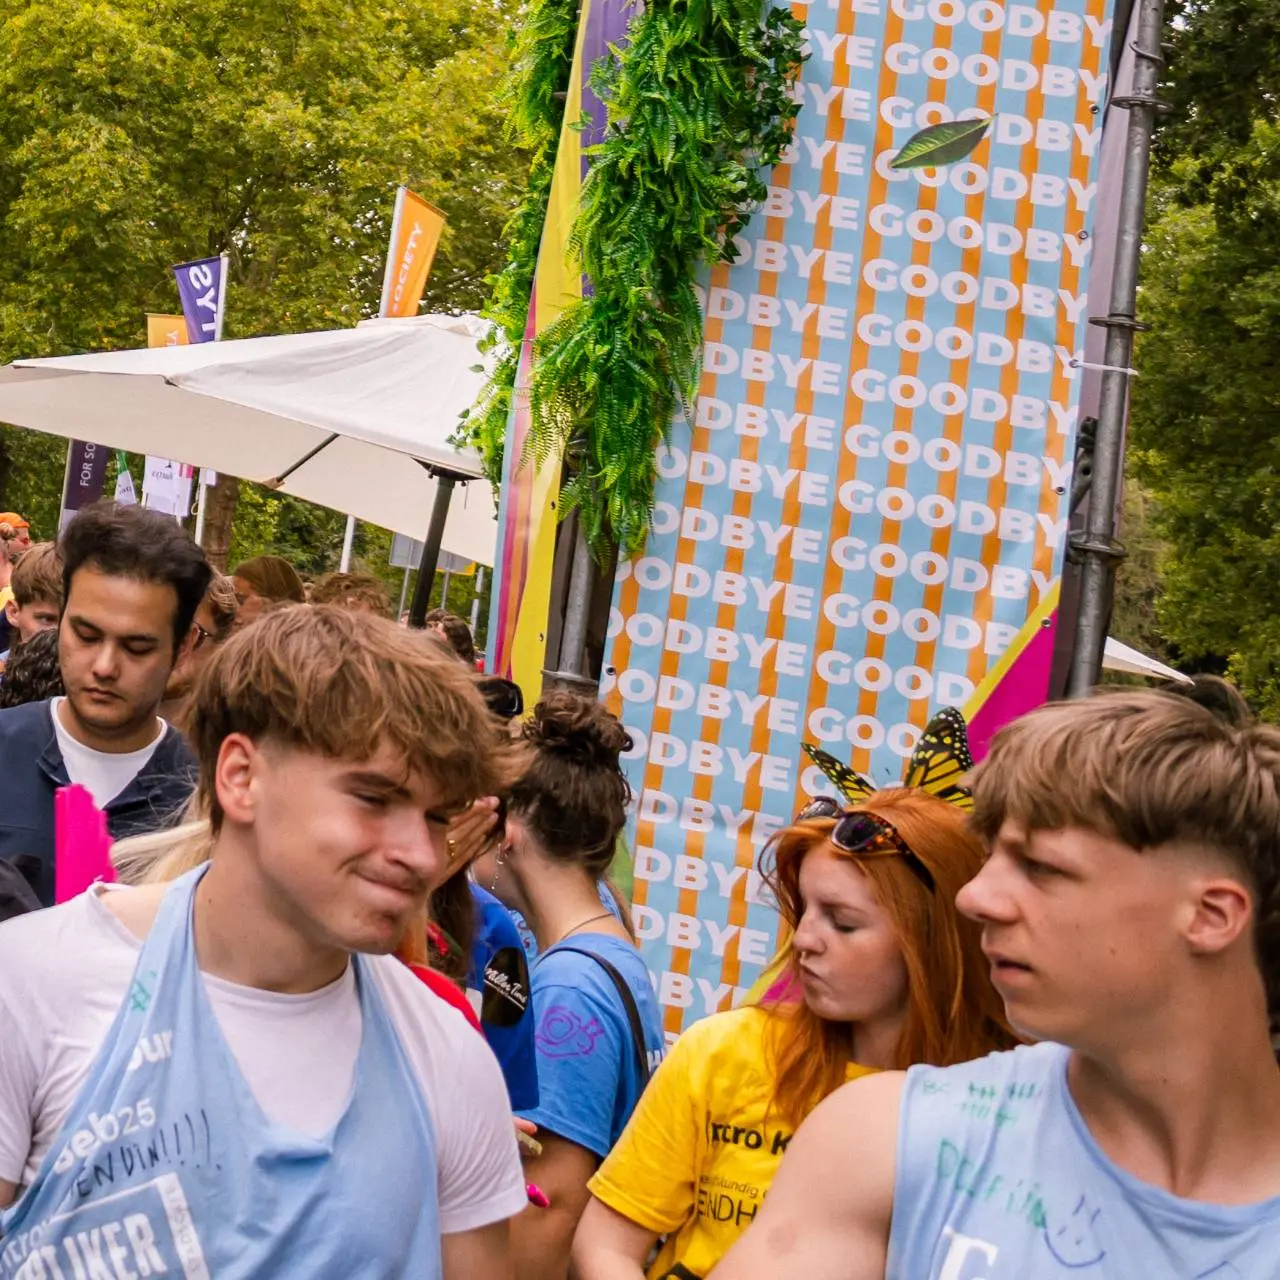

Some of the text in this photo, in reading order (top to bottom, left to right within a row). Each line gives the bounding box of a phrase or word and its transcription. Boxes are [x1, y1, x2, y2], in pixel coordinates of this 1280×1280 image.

[884, 43, 1107, 102] GOODBY
[868, 202, 1092, 268] GOODBY
[863, 257, 1087, 323] GOODBY
[857, 313, 1083, 379] GOODBY
[851, 368, 1078, 435] GOODBY
[844, 424, 1073, 491] GOODBY
[838, 480, 1068, 548] GOODBY
[831, 536, 1061, 604] GOODBY
